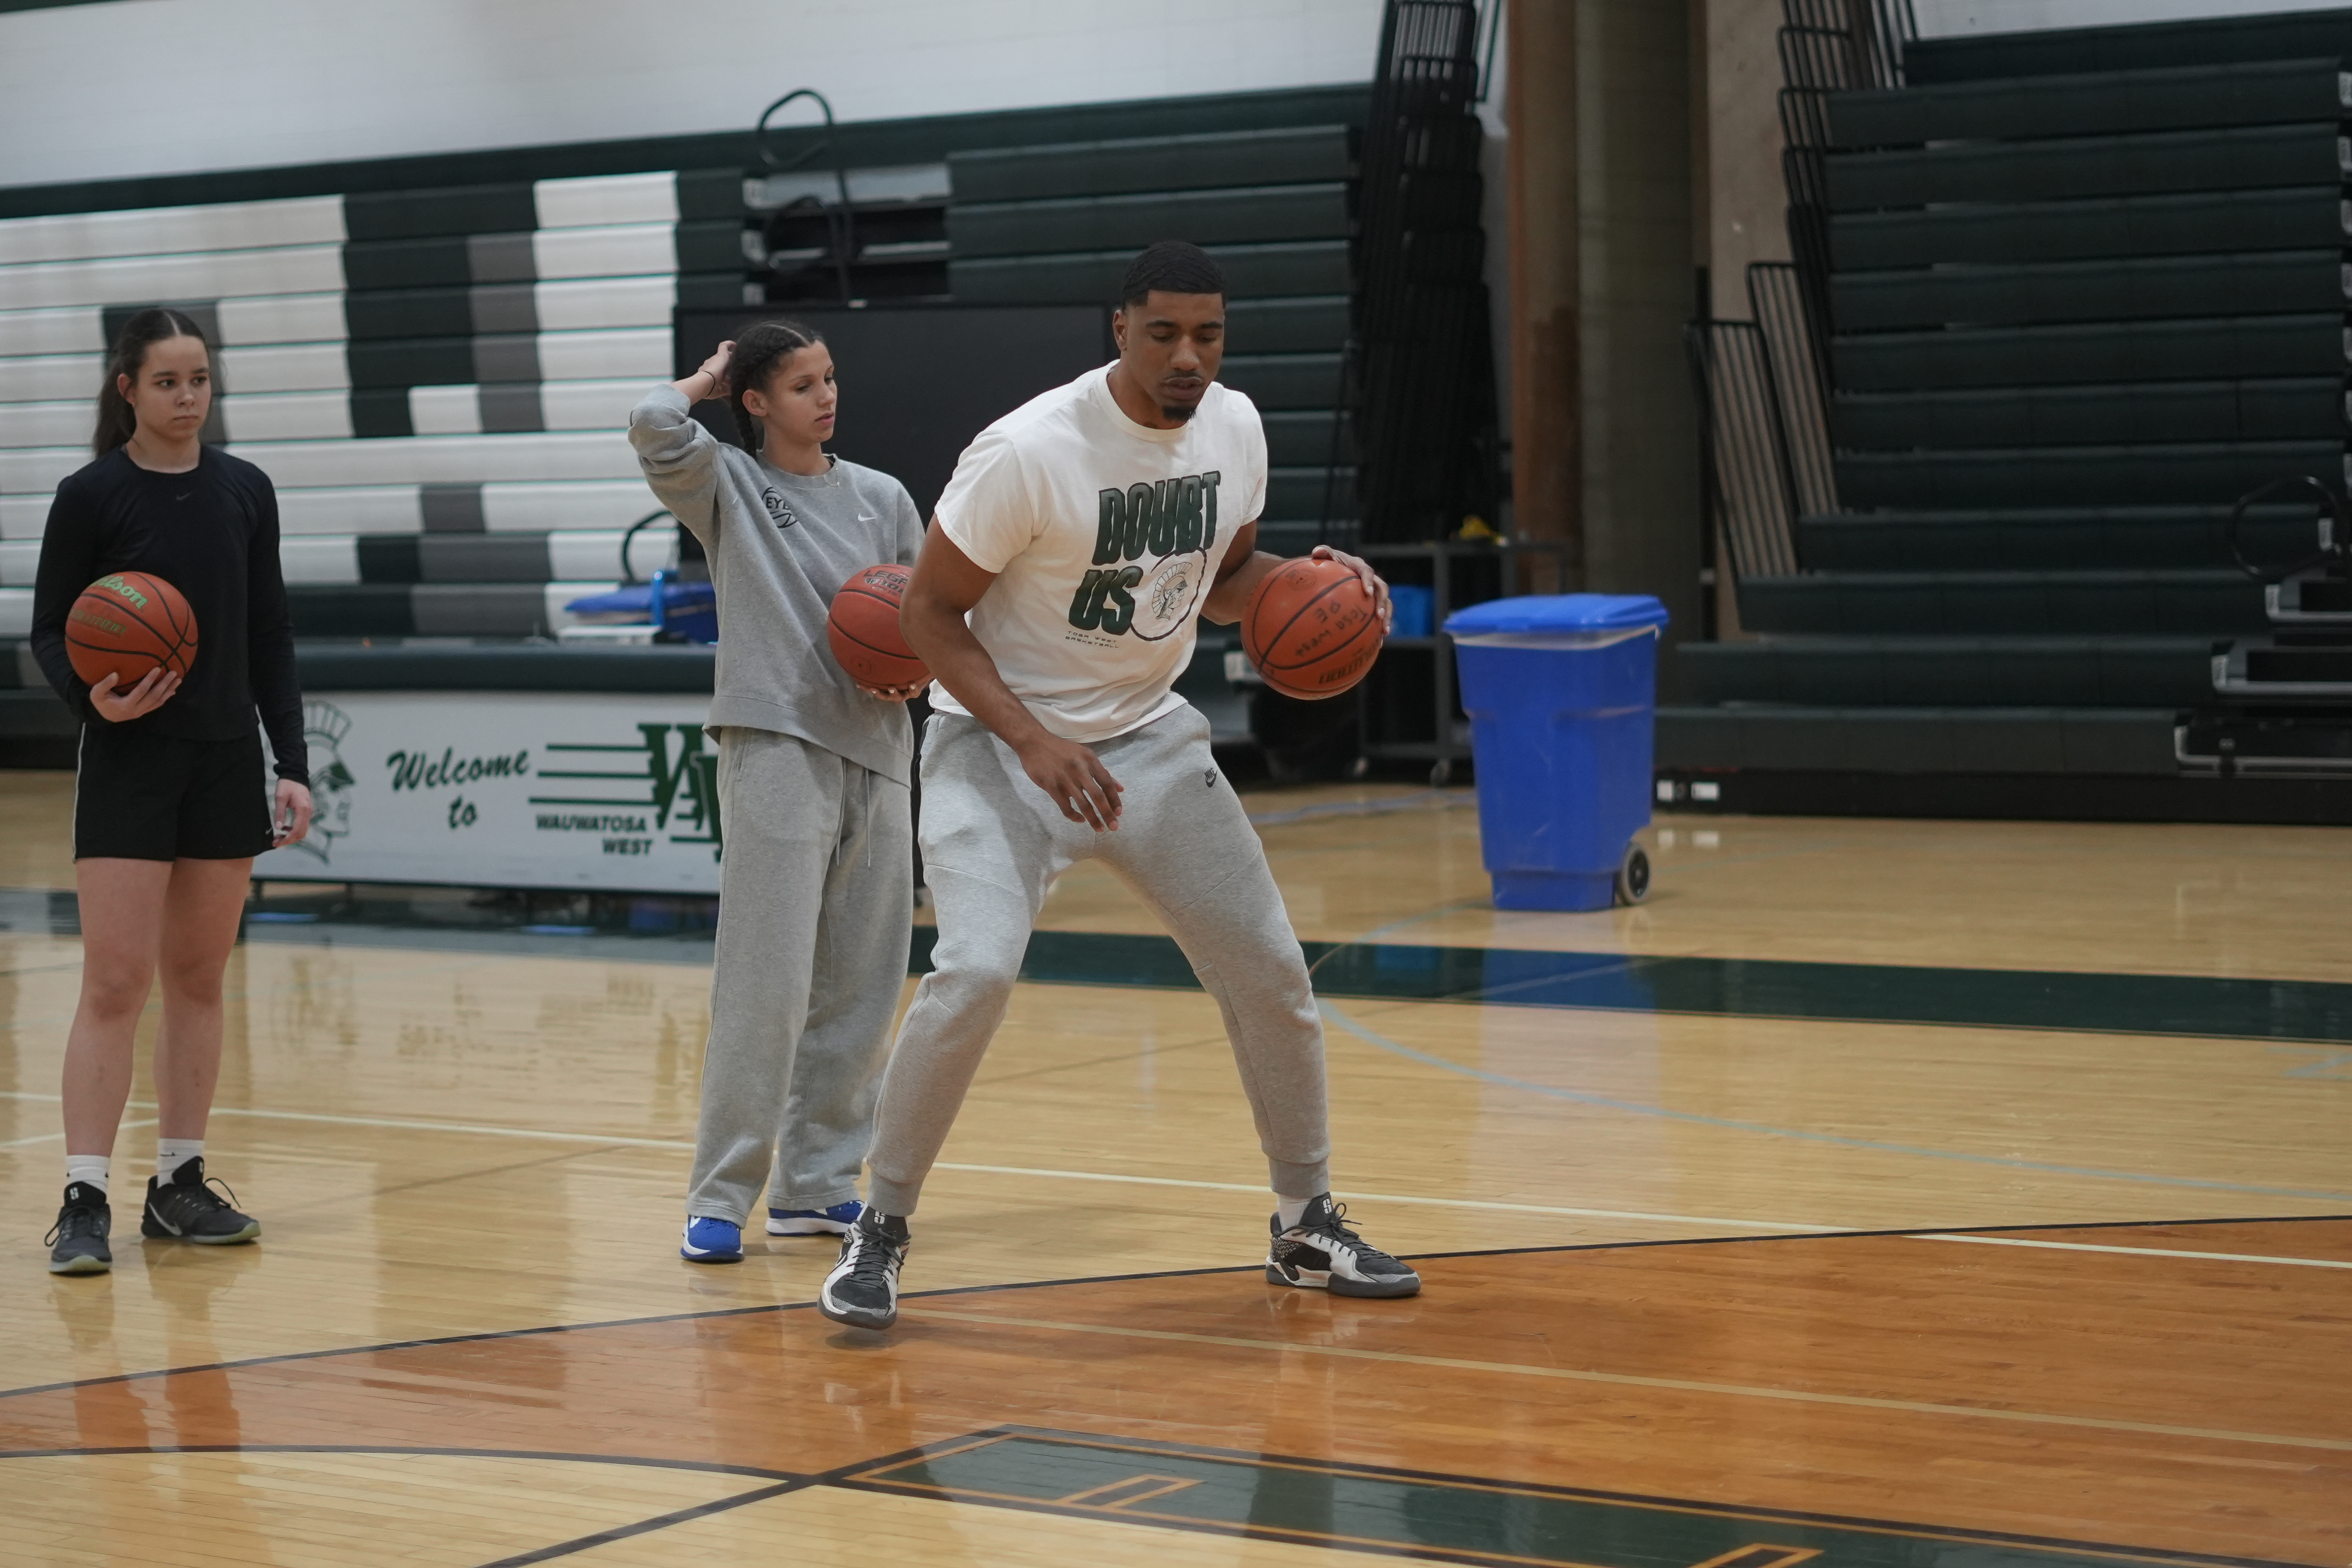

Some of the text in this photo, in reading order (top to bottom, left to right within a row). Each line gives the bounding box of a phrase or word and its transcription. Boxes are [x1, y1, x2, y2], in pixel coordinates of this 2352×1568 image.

[1091, 470, 1221, 566] DOUBT
[1068, 565, 1144, 636] US
[1065, 635, 1120, 648] BASKETBALL
[1068, 630, 1089, 639] TOSA
[386, 746, 530, 792] Welcome
[448, 795, 479, 830] to
[535, 814, 647, 833] WAUWATOSA
[602, 838, 654, 856] WEST
